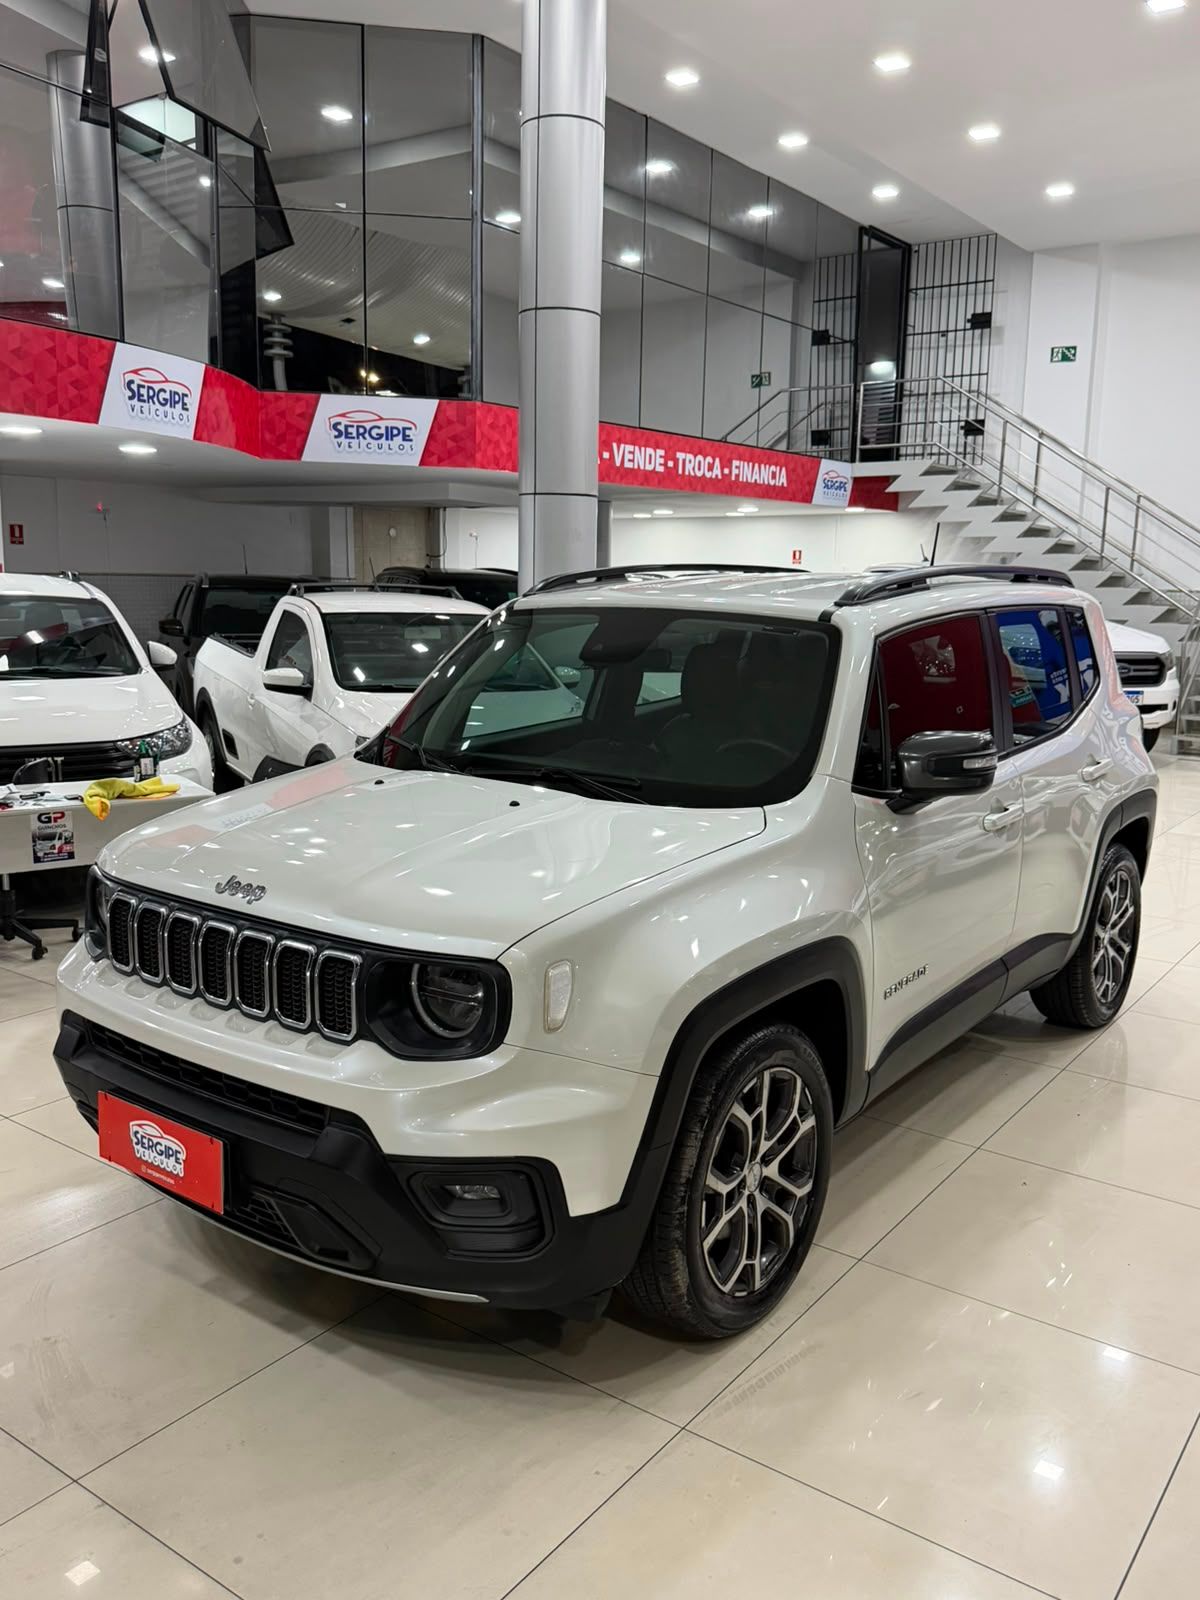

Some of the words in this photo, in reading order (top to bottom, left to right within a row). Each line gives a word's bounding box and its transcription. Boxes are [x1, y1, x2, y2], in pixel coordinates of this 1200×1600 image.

[126, 379, 189, 411] SERGIPE
[130, 404, 190, 423] VEÍCULOS
[332, 421, 413, 442] SERGIPE
[336, 439, 414, 451] VEÍCULOS
[612, 442, 665, 473] VENDE
[676, 452, 722, 480] TROCA
[731, 460, 788, 487] FINANCIA
[822, 478, 847, 492] SERGIPE
[37, 811, 65, 824] GP
[215, 874, 267, 905] Jeep
[133, 1130, 182, 1165] SERGIPE
